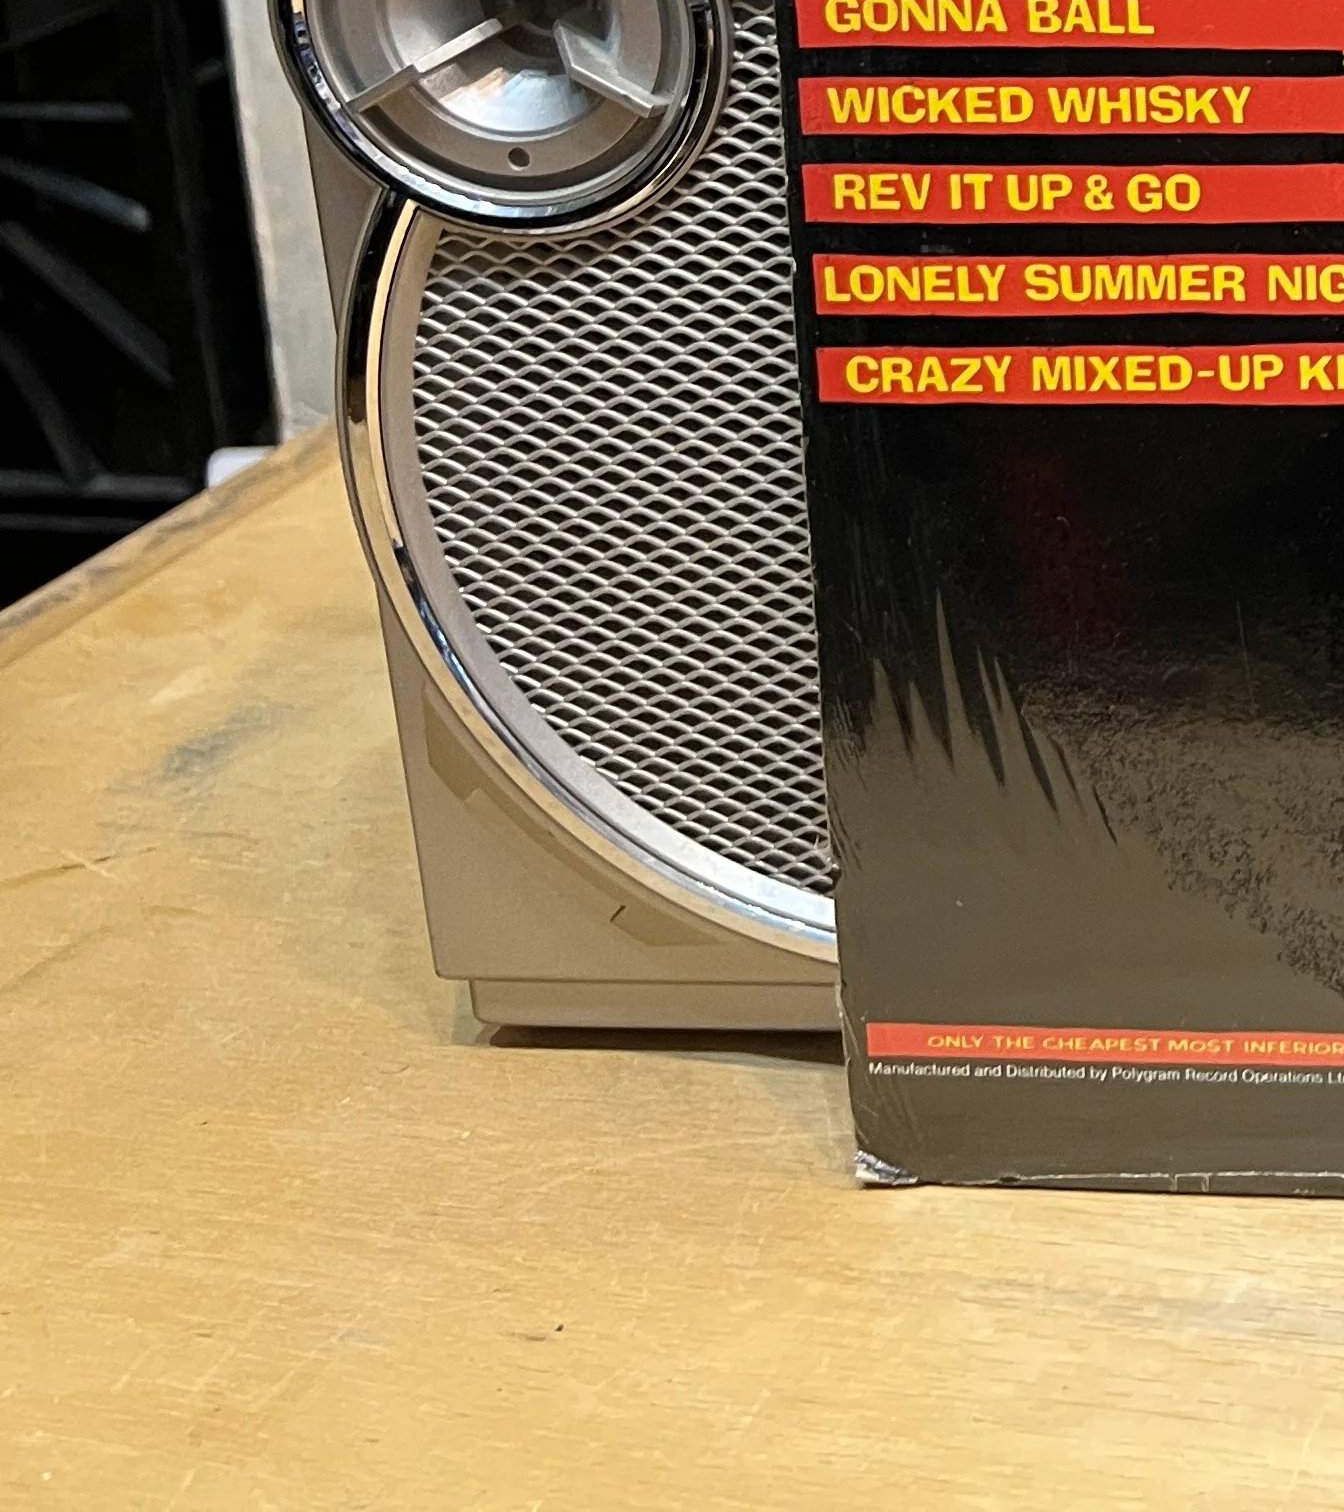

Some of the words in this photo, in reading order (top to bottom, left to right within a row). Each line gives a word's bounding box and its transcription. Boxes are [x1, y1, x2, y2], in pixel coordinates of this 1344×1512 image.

[827, 85, 1034, 123] WICKED
[1047, 85, 1250, 124] WHISKY
[833, 173, 930, 210] REV
[949, 173, 993, 210] IT
[1006, 173, 1073, 211] UP
[1084, 174, 1114, 211] &
[1126, 173, 1200, 212] GO
[824, 264, 1005, 302] LONELY
[1024, 263, 1245, 302] SUMMER
[845, 355, 1011, 393] CRAZY
[1032, 354, 1284, 392] MIXED-UP
[927, 1035, 983, 1049] ONLY
[992, 1035, 1033, 1050] THE
[1042, 1037, 1160, 1052] CHEAPEST
[1167, 1039, 1233, 1053] MOST
[868, 1062, 971, 1077] Manufactured
[974, 1064, 1002, 1077] and
[1006, 1064, 1086, 1079] Distributed
[1089, 1066, 1108, 1082] by
[1111, 1066, 1181, 1083] Polygram
[1185, 1067, 1238, 1083] Record
